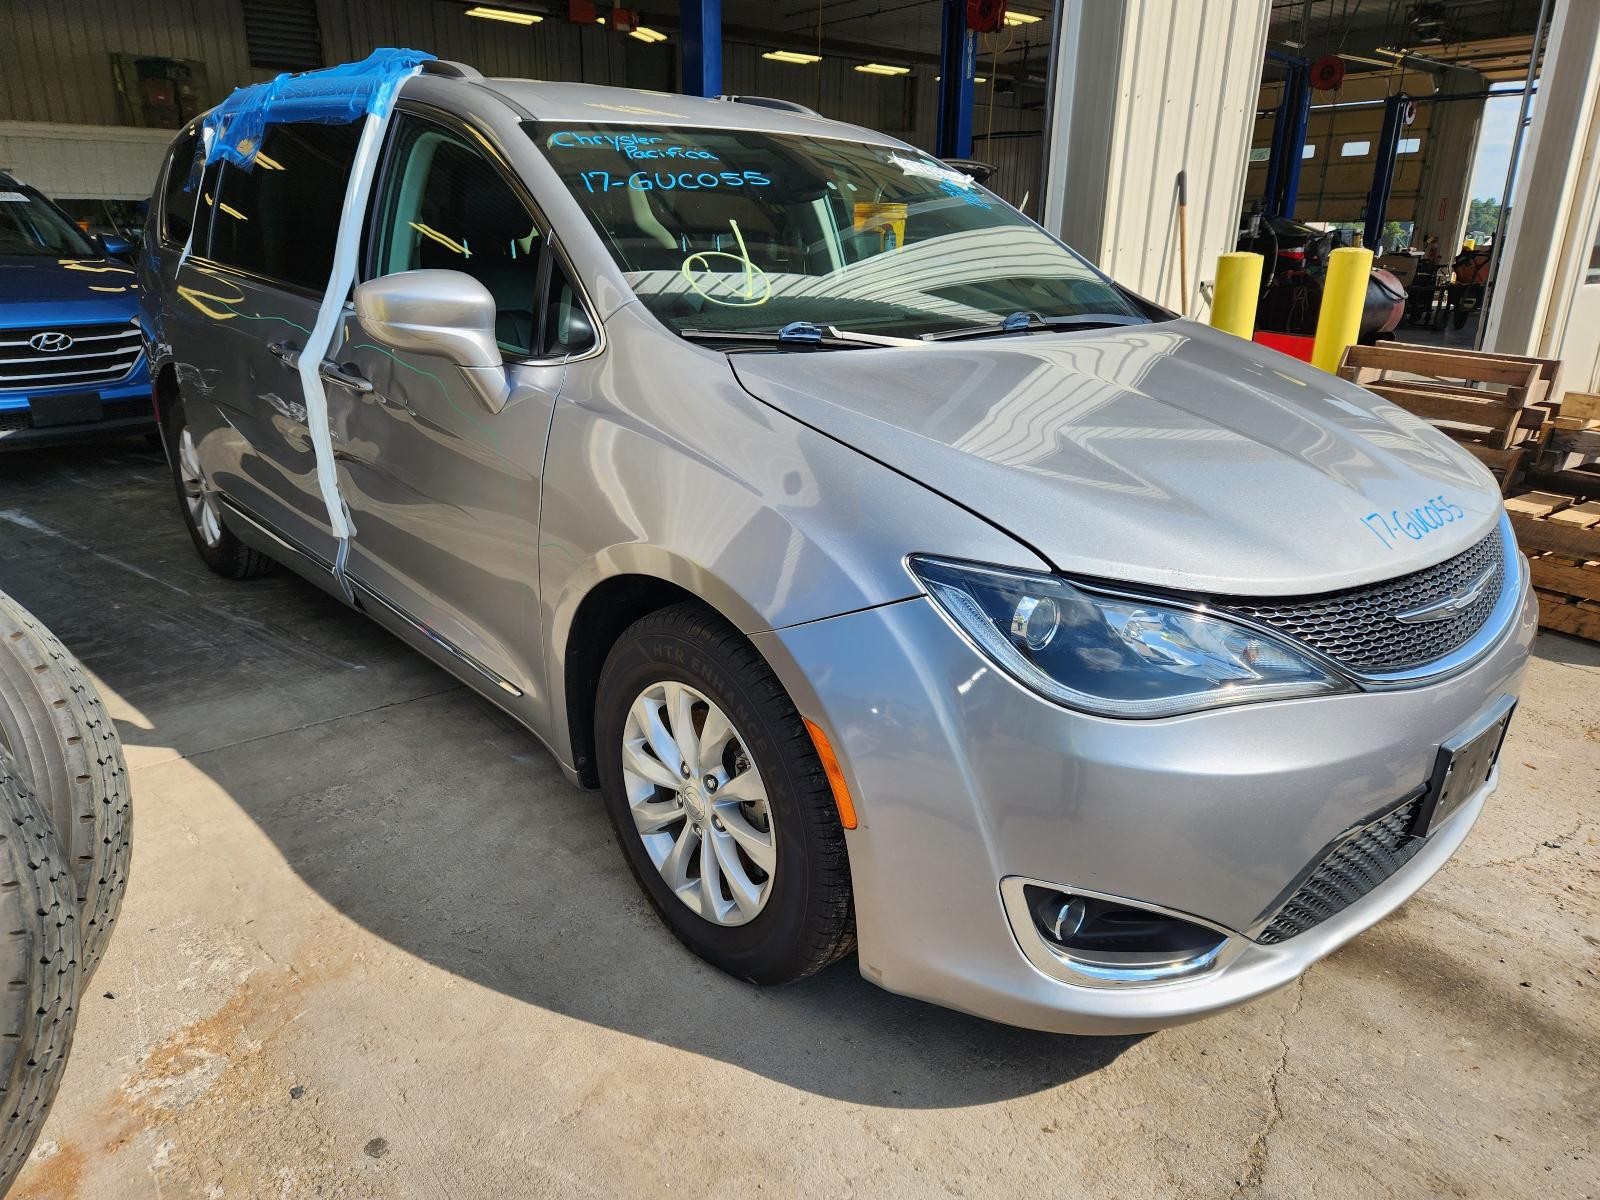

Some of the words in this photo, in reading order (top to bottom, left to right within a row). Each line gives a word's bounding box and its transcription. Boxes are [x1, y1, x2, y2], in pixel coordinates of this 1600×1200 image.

[551, 131, 663, 152] Chrysler
[624, 146, 720, 161] Pacifica
[580, 171, 771, 193] 17-GUC055
[1359, 495, 1464, 550] 17-GUC055
[653, 643, 686, 664] HTR
[690, 658, 768, 753] ENHANCE
